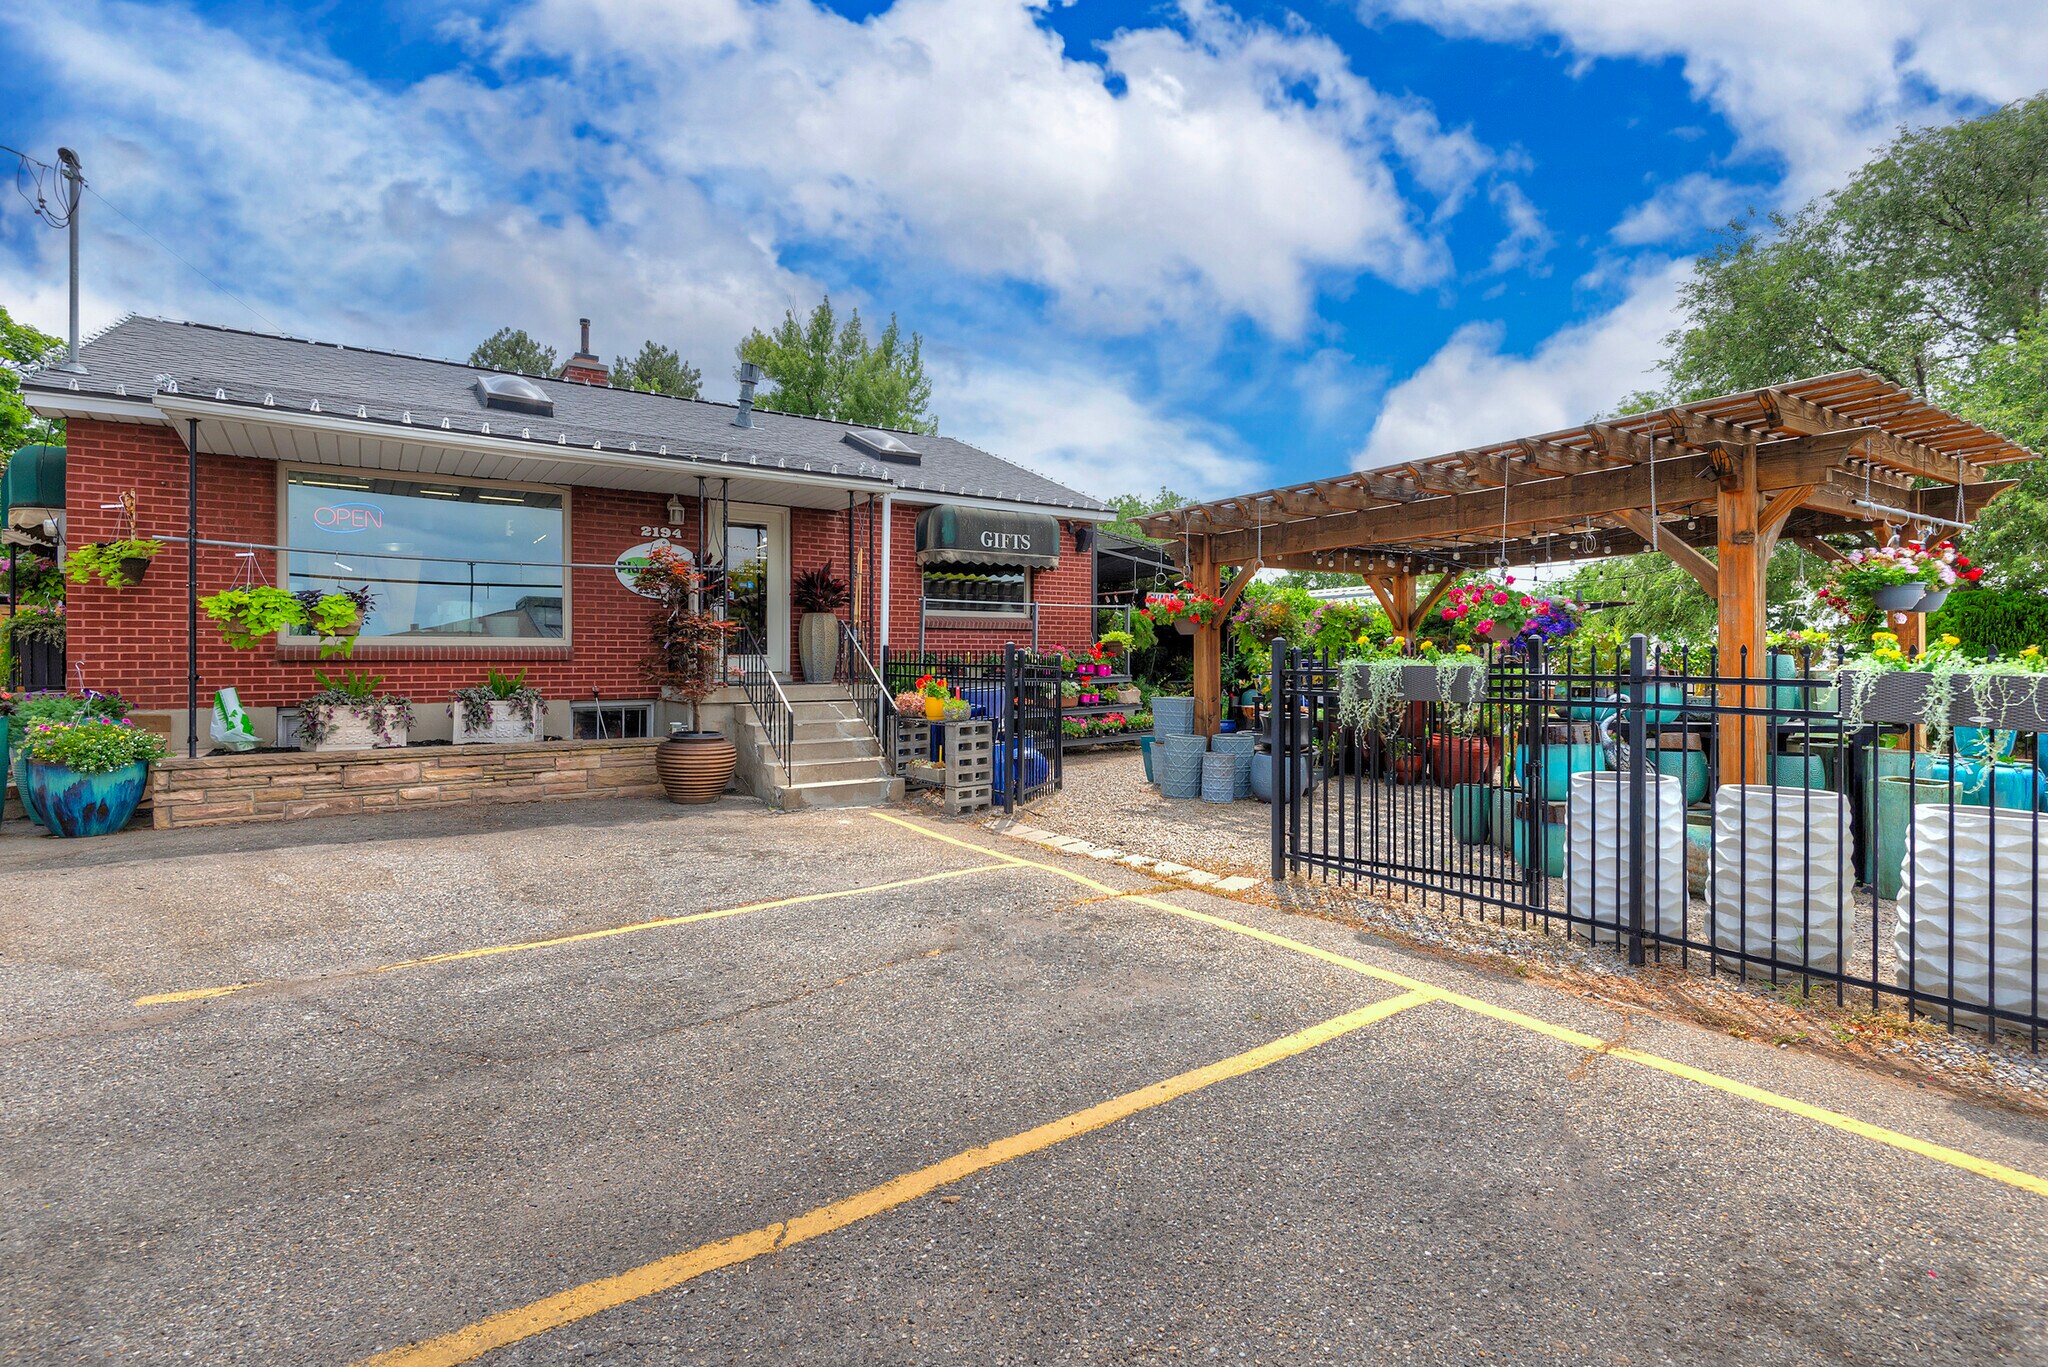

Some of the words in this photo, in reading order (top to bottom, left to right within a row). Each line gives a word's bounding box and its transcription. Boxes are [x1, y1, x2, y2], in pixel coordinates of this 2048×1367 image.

[313, 506, 382, 529] OPEN
[640, 525, 682, 539] 2194
[980, 530, 1031, 550] GIFTS
